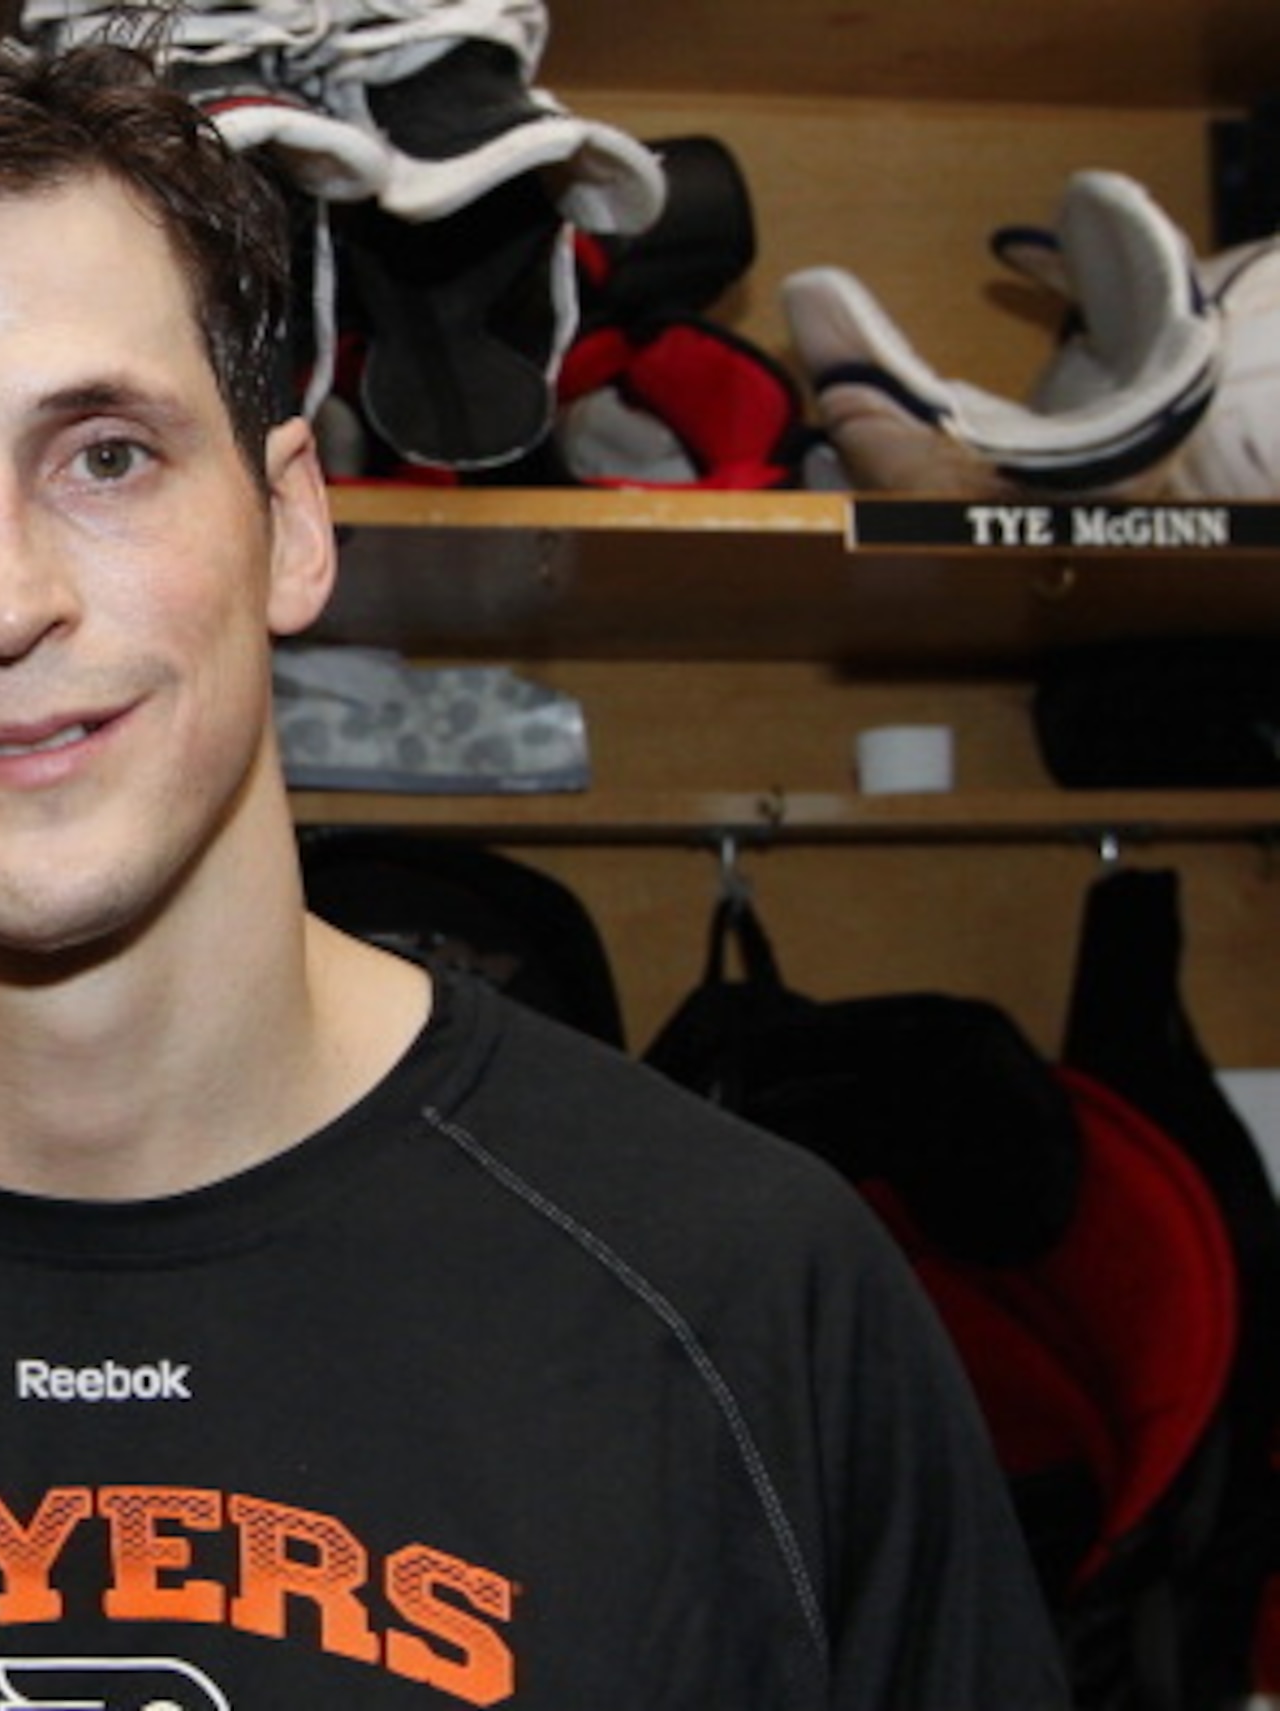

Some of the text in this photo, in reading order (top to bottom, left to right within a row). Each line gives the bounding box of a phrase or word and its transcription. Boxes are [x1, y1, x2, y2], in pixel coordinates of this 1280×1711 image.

[967, 506, 1230, 545] TYE McGINN
[16, 1359, 192, 1400] Reebok
